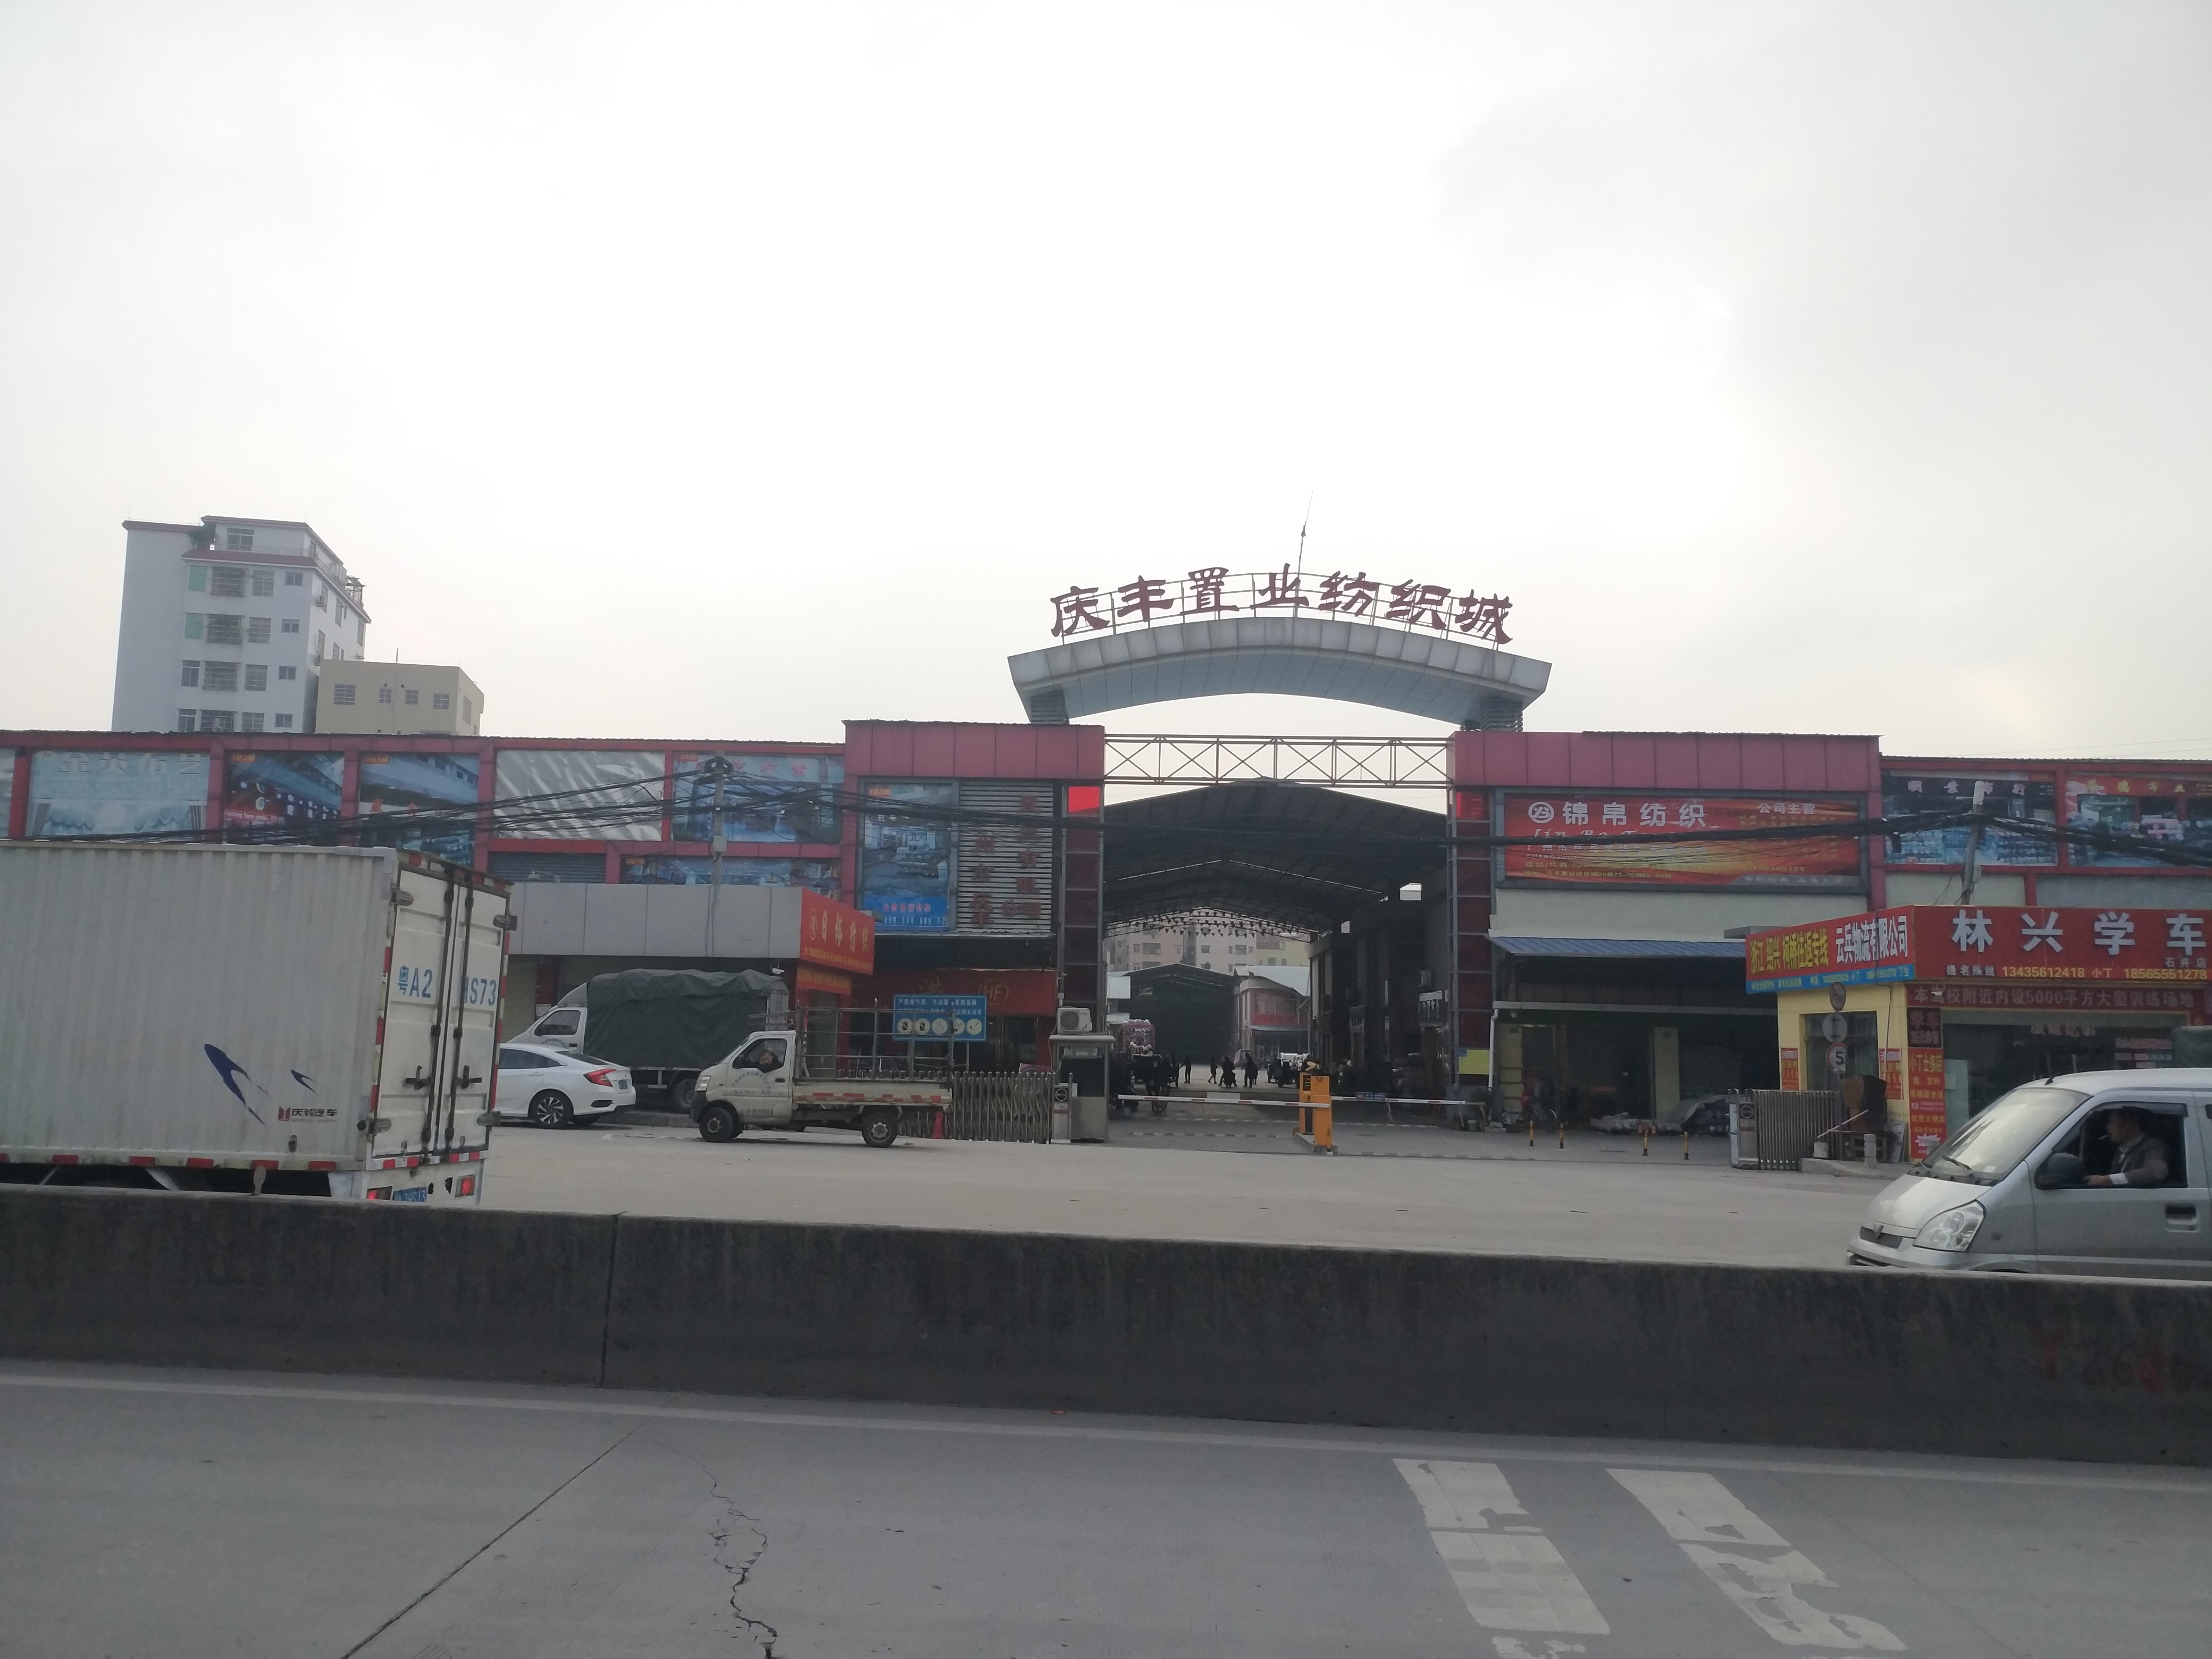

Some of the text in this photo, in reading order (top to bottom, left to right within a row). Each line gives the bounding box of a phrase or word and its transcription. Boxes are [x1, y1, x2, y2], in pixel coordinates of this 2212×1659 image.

[1051, 564, 1513, 644] 庆丰置业纺织城
[1562, 801, 1706, 827] 锦帛纺织
[1758, 802, 1816, 815] 公司主营
[1835, 915, 1908, 964] 云兵物流有限公司
[1951, 909, 2207, 956] 林兴学车
[1946, 965, 2207, 980] 报名热线 13435612418 小丁 18565551278
[2165, 957, 2207, 968] 石井店
[398, 965, 433, 998] 粤A2
[984, 985, 1003, 1000] HF
[1836, 1051, 1844, 1065] 5
